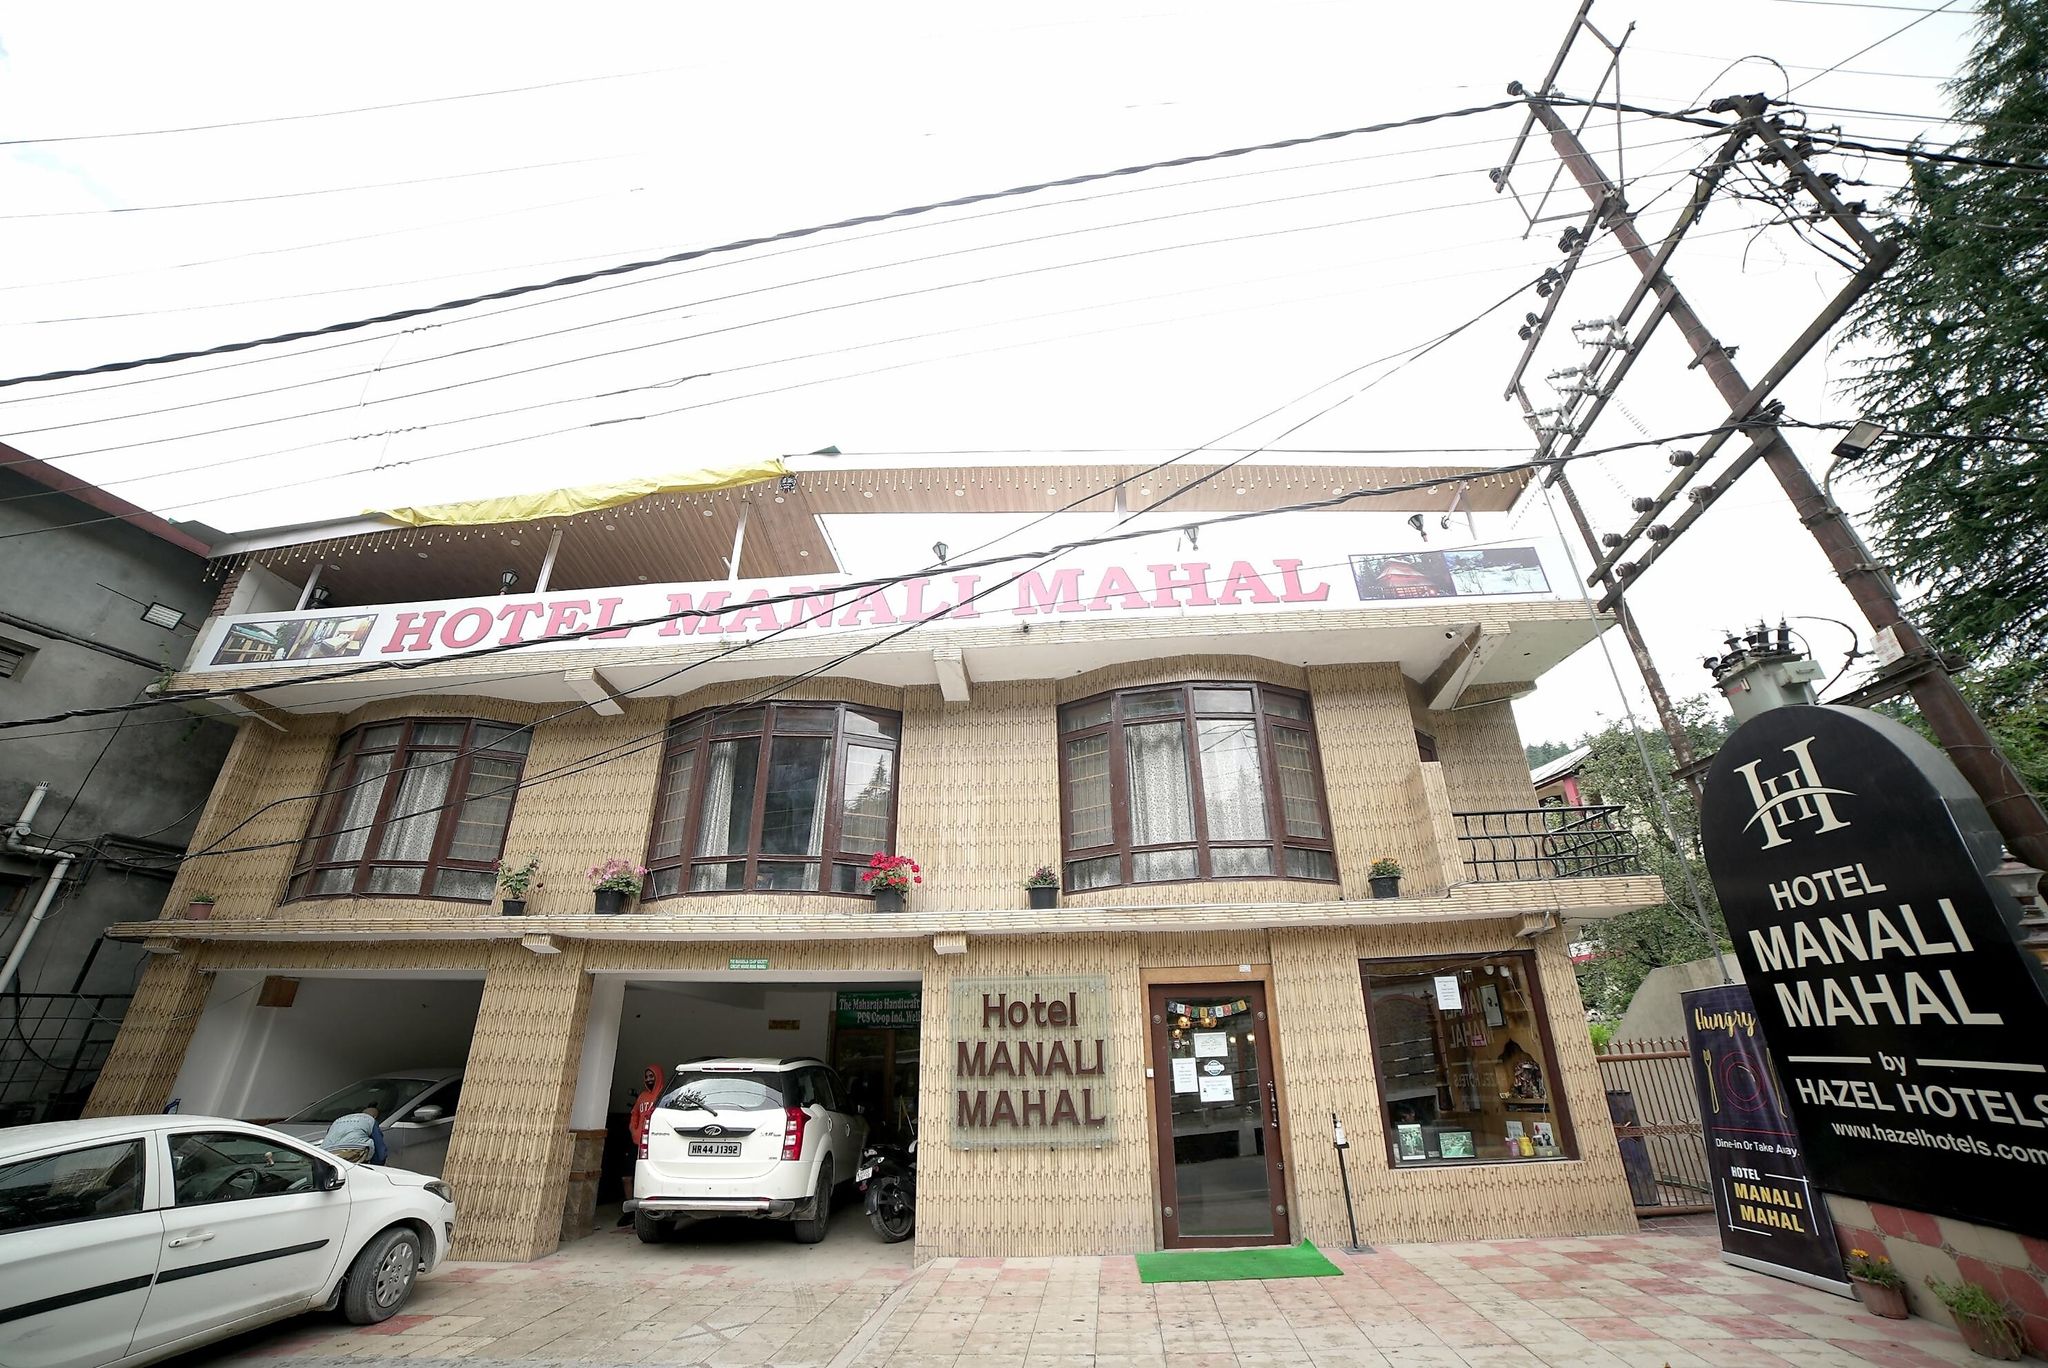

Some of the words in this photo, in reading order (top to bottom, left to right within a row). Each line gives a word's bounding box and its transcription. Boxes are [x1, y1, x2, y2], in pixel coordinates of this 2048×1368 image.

[381, 597, 632, 654] HOTEL
[659, 575, 982, 637] MANALI
[1011, 559, 1331, 618] MAHAL
[1769, 862, 1887, 911] HOTEL
[1748, 897, 1974, 973] MANALI
[840, 998, 852, 1010] The
[852, 998, 883, 1012] Maharaja
[982, 991, 1079, 1028] Hotel
[1773, 969, 2005, 1029] MAHAL
[1694, 1006, 1757, 1038] Hungry
[957, 1039, 1105, 1077] MANALI
[1878, 1051, 1908, 1077] by
[957, 1088, 1106, 1127] MAHAL
[1795, 1078, 1896, 1112] HAZEL
[691, 1145, 713, 1154] HR44
[715, 1145, 738, 1154] J1392
[1715, 1138, 1743, 1150] Dine-in
[1743, 1140, 1753, 1151] Or
[1753, 1141, 1775, 1153] Take
[1831, 1121, 2048, 1166] www.hazelhotels.com
[1730, 1166, 1761, 1181] HOTEL
[1734, 1182, 1804, 1210] MANALI
[1740, 1204, 1805, 1233] MAHAL
